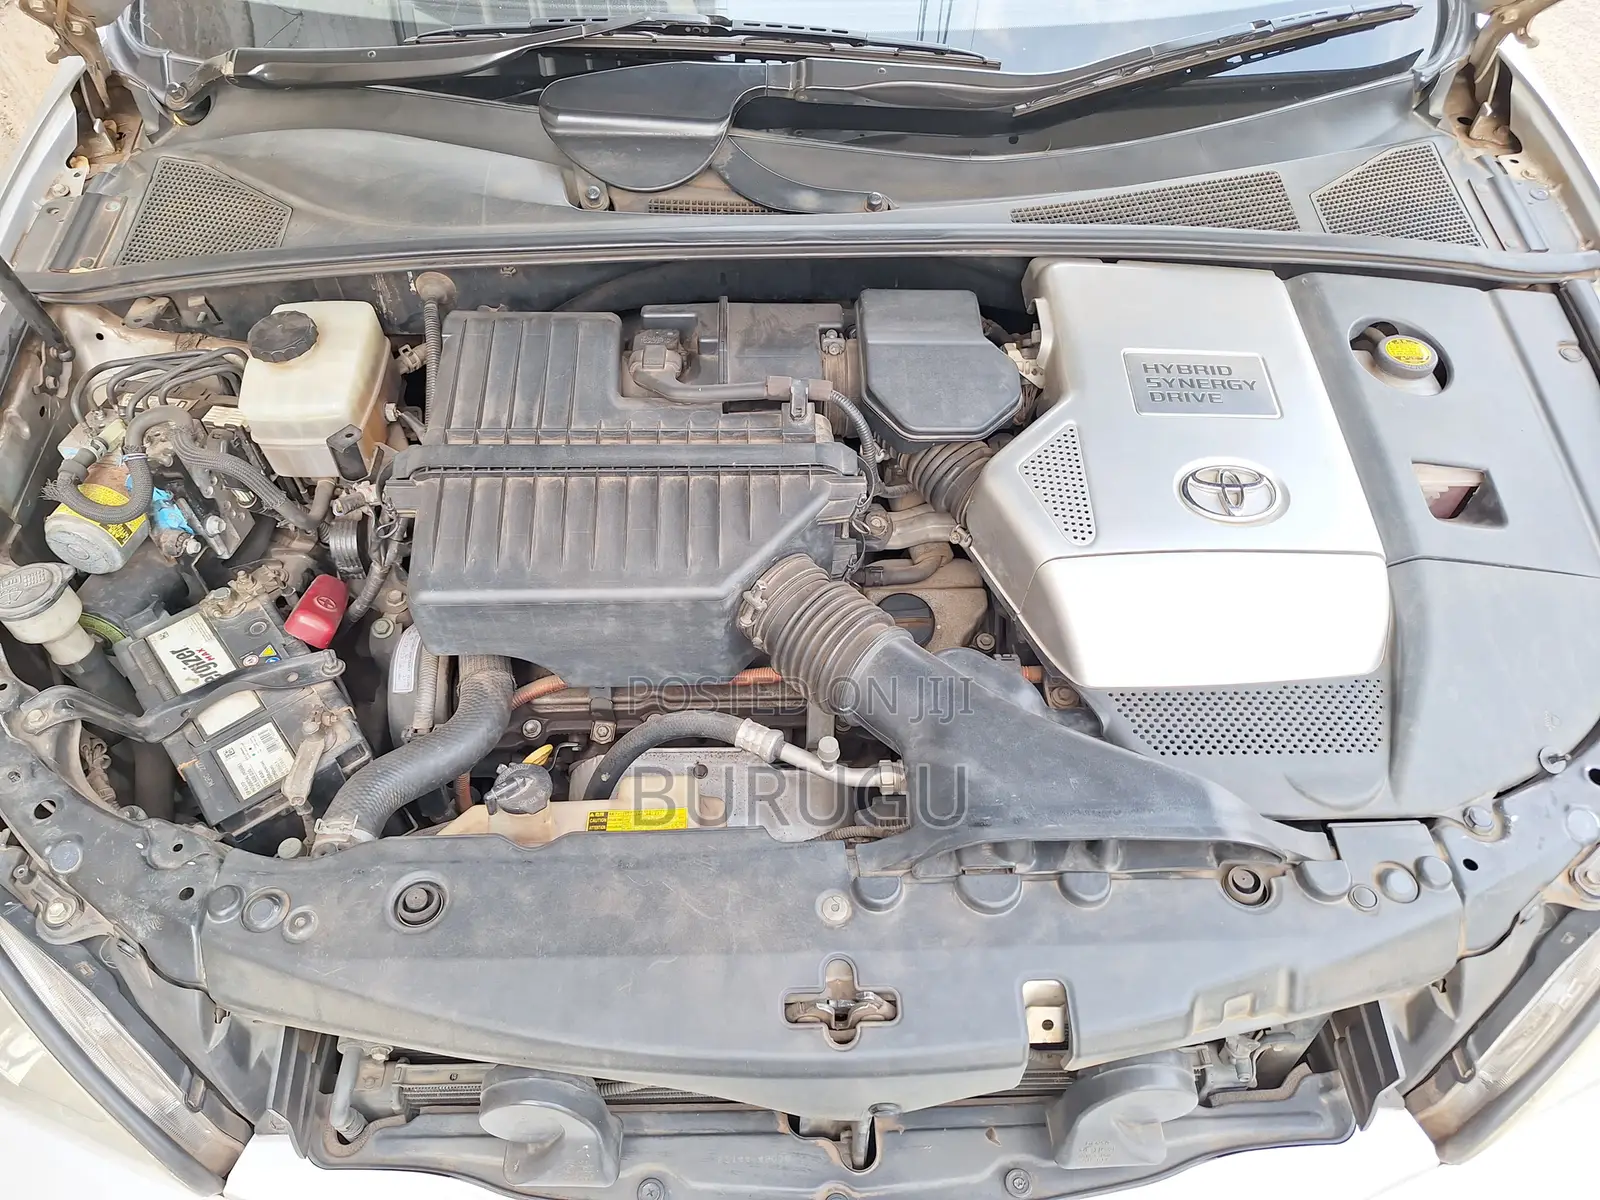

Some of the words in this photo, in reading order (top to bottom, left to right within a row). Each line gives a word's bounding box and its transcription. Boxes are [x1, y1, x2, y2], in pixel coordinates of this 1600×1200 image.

[1142, 363, 1233, 376] HYBRID
[1145, 377, 1257, 391] SYNERGY
[1149, 391, 1224, 404] DRIVE
[195, 647, 216, 661] MAX
[171, 646, 223, 685] ergizer
